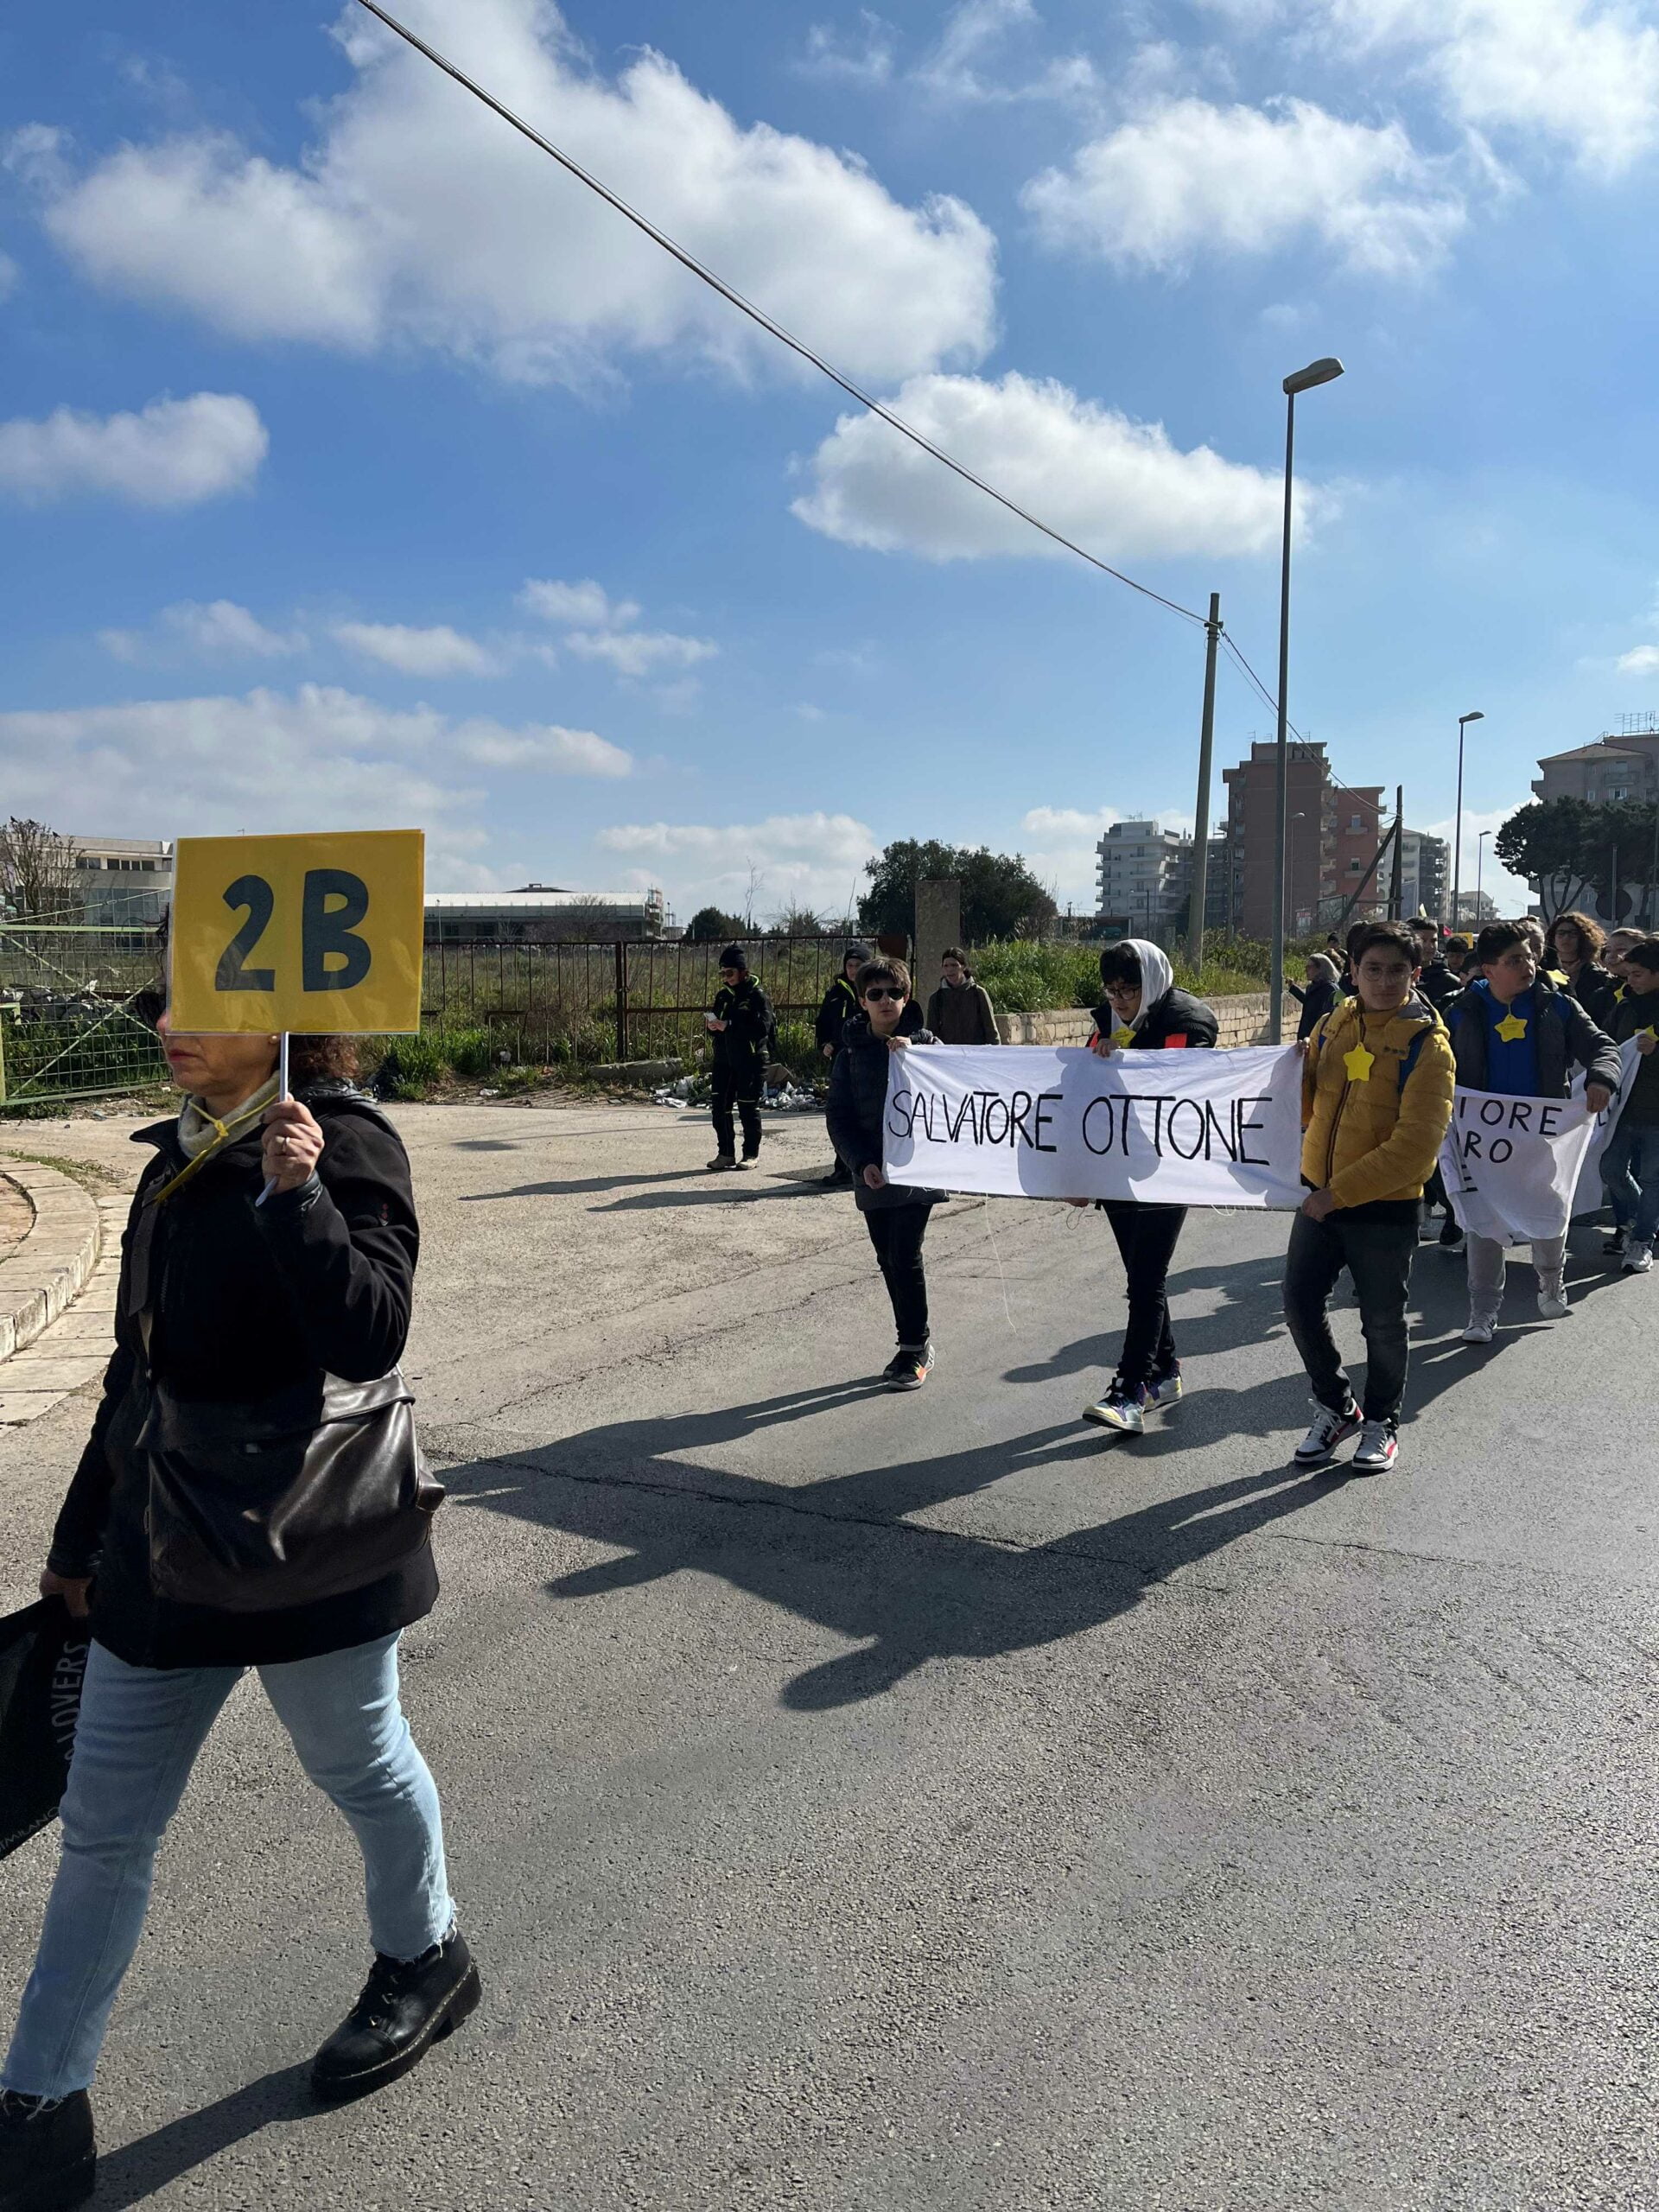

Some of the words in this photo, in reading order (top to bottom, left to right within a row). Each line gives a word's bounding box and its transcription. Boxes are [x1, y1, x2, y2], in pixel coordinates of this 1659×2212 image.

[888, 1090, 1064, 1153] SALVATORE
[1082, 1093, 1273, 1166] OTTONE
[1456, 1130, 1513, 1164] RO
